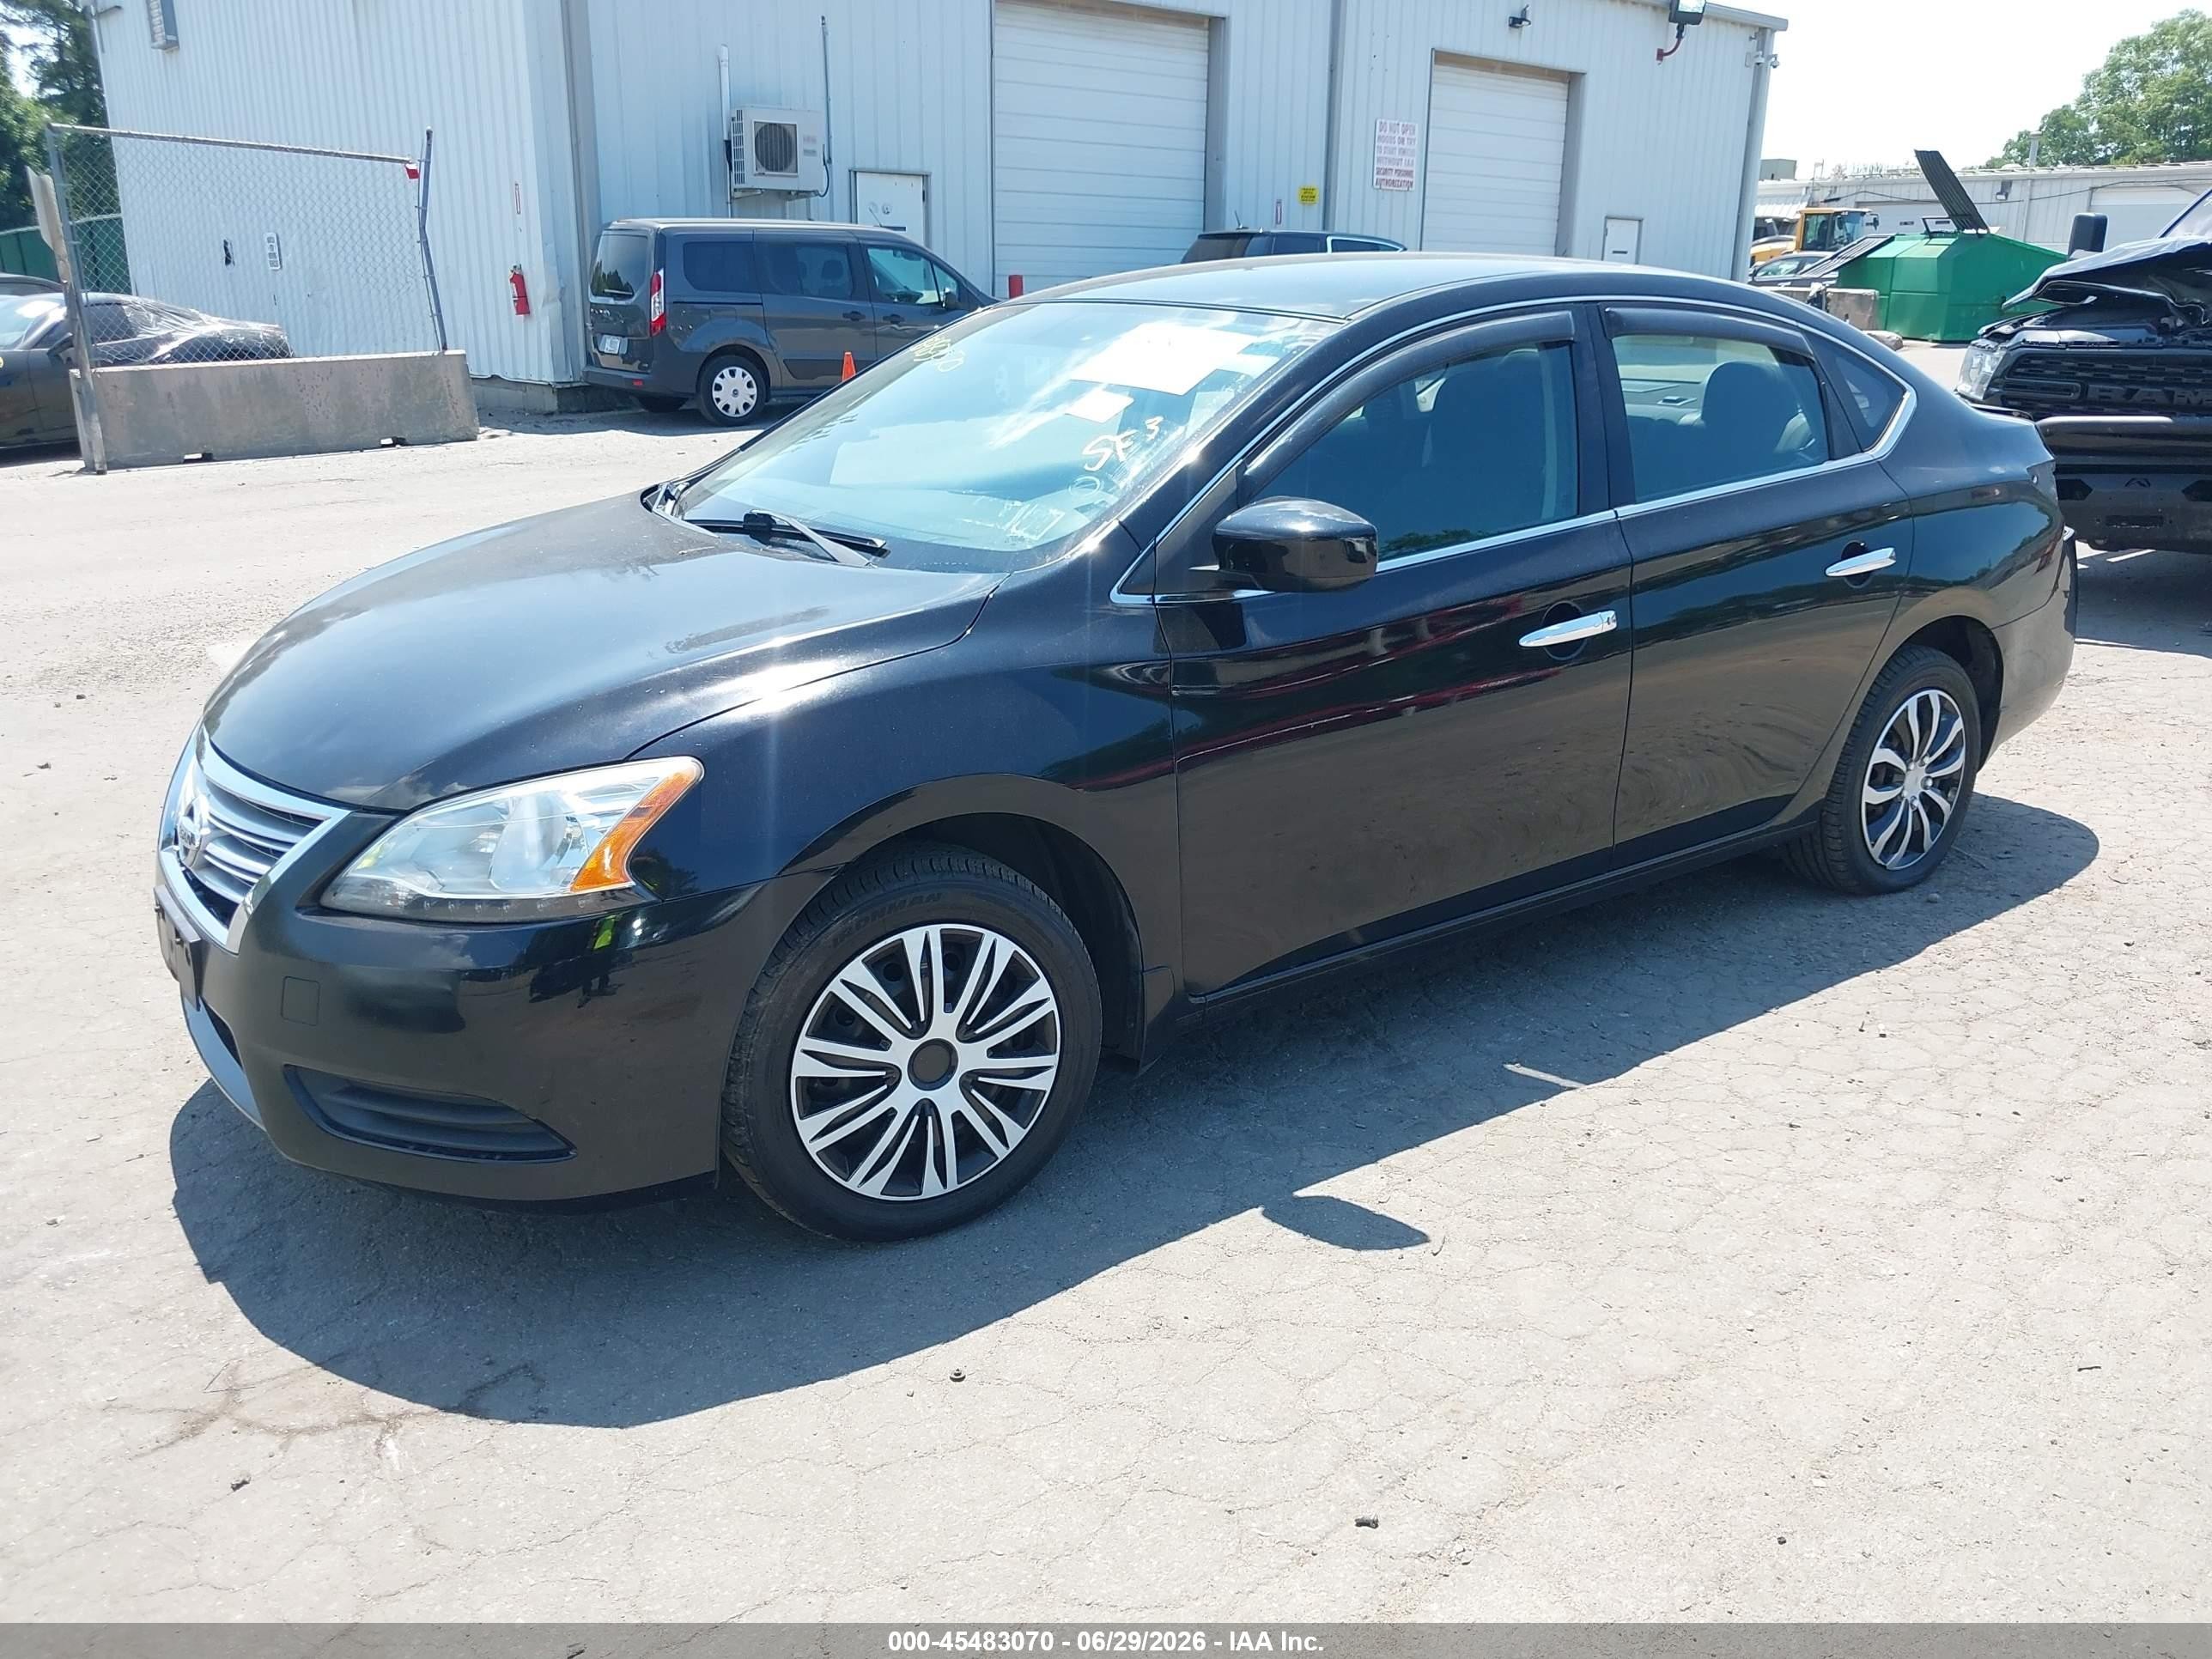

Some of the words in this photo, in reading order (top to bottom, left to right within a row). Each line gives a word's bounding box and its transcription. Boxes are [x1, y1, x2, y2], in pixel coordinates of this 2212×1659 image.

[1378, 121, 1388, 133] DO
[1389, 122, 1400, 135] NOT
[1401, 123, 1416, 137] OPEN
[1397, 136, 1406, 146] OR
[1407, 137, 1417, 146] TRY
[1376, 144, 1382, 155] TO
[1376, 156, 1403, 167] WITHOUT
[1376, 167, 1394, 177] SECURITY
[1375, 178, 1414, 188] AUTHORIZATION
